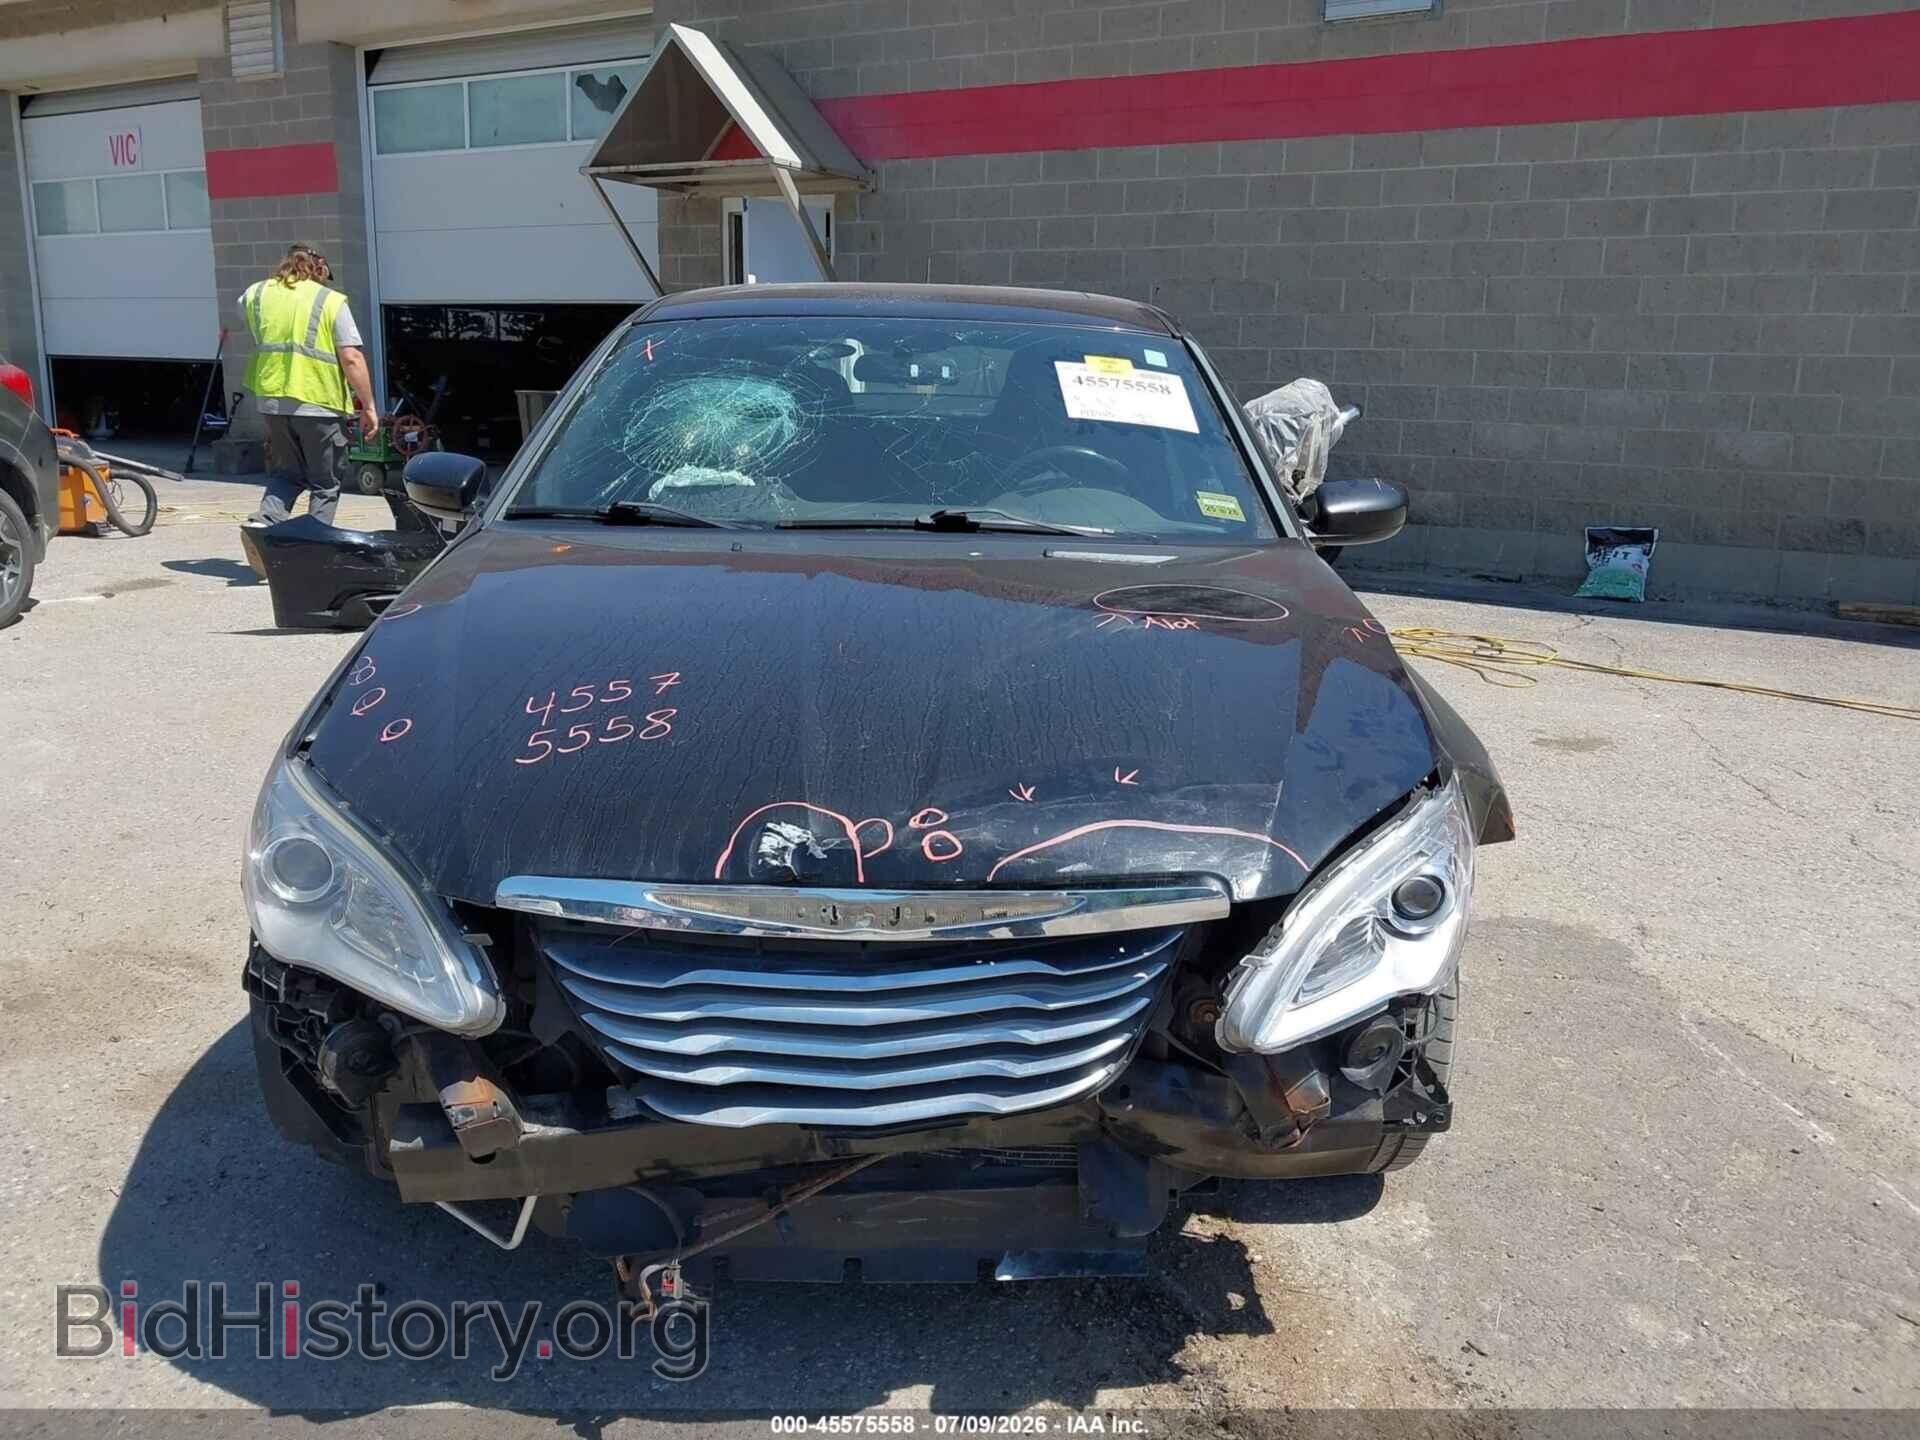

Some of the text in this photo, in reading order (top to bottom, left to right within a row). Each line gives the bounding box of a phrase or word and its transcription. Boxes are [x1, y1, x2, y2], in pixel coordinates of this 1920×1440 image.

[108, 133, 137, 166] VIC
[1072, 375, 1173, 396] 45575558
[525, 671, 681, 726] 4557
[514, 708, 678, 765] 5558
